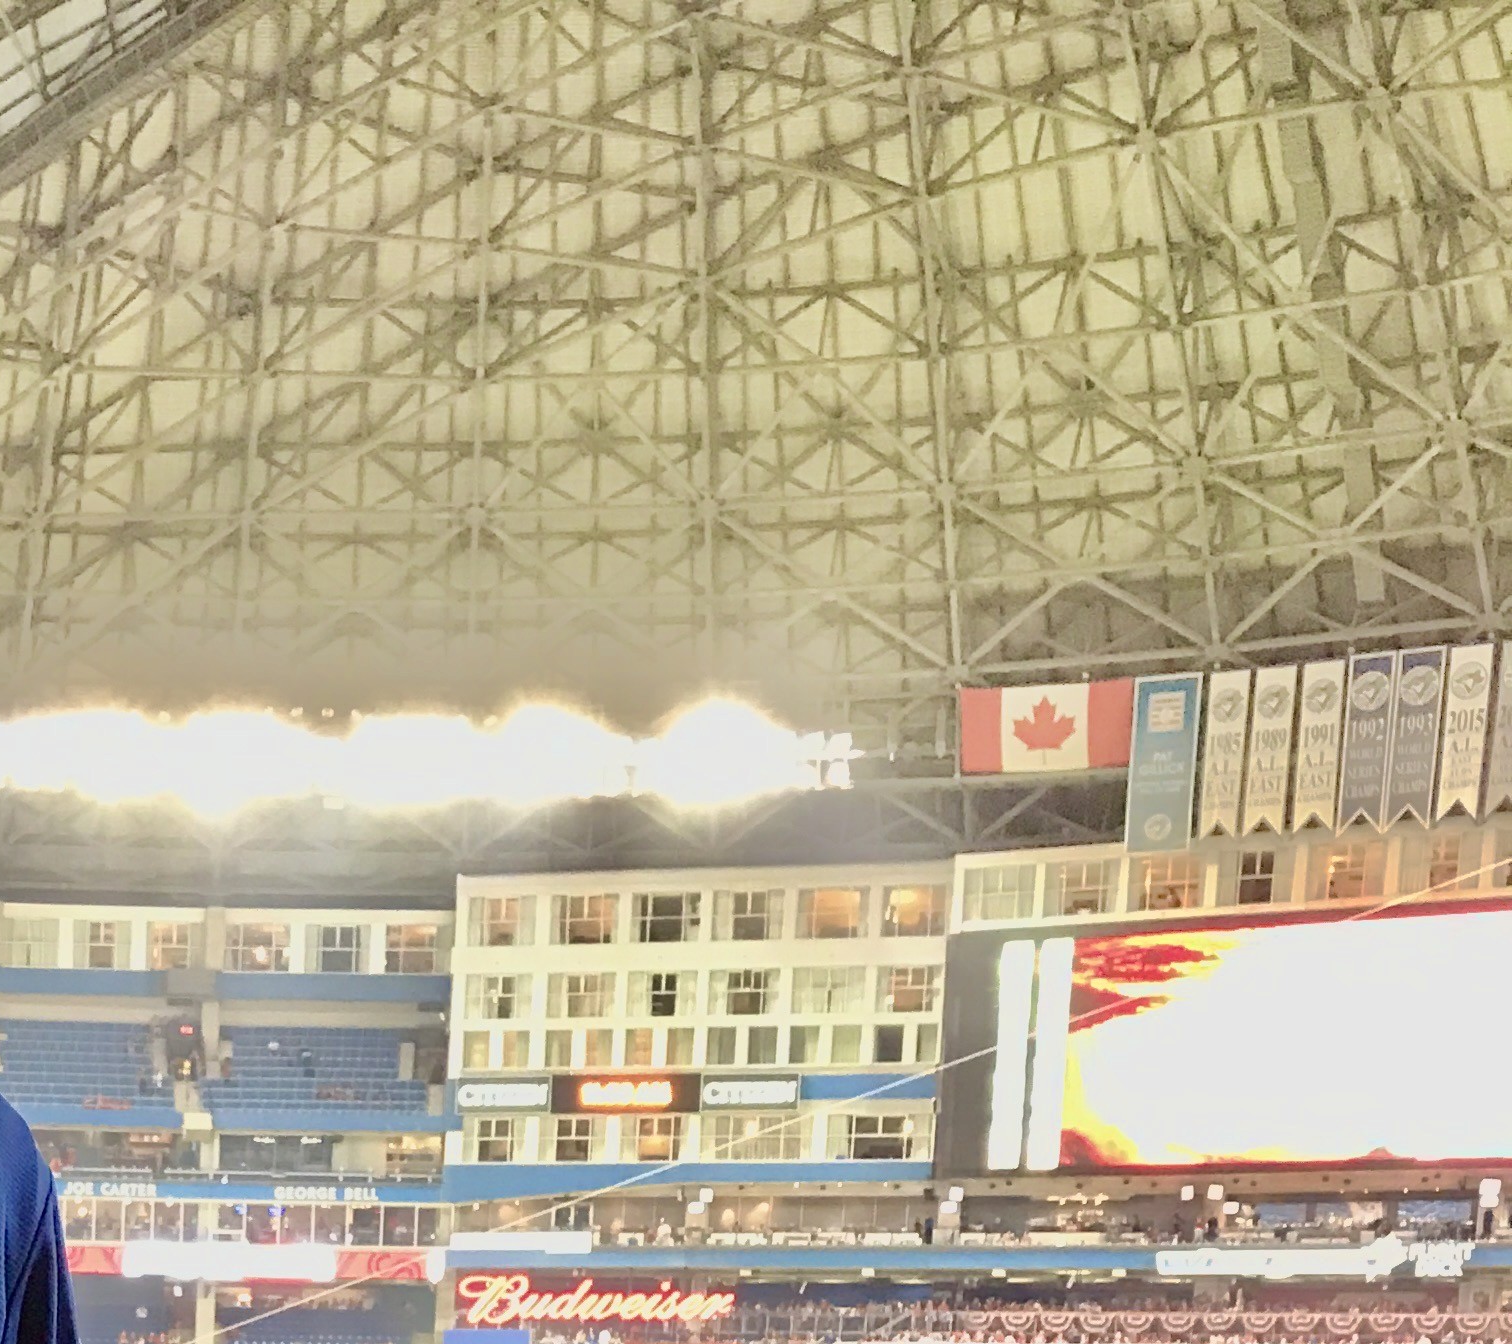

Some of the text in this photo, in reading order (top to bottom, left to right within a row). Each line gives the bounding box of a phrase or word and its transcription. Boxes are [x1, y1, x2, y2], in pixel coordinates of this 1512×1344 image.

[1352, 717, 1385, 743] 1992
[1400, 713, 1433, 738] 1993
[1448, 708, 1485, 733] 2015
[1255, 728, 1287, 750] 1989
[1304, 723, 1335, 748] 1991
[64, 1182, 158, 1197] JOE CARTER
[274, 1186, 379, 1201] GEORGE BELL
[457, 1271, 736, 1325] Budweiser
